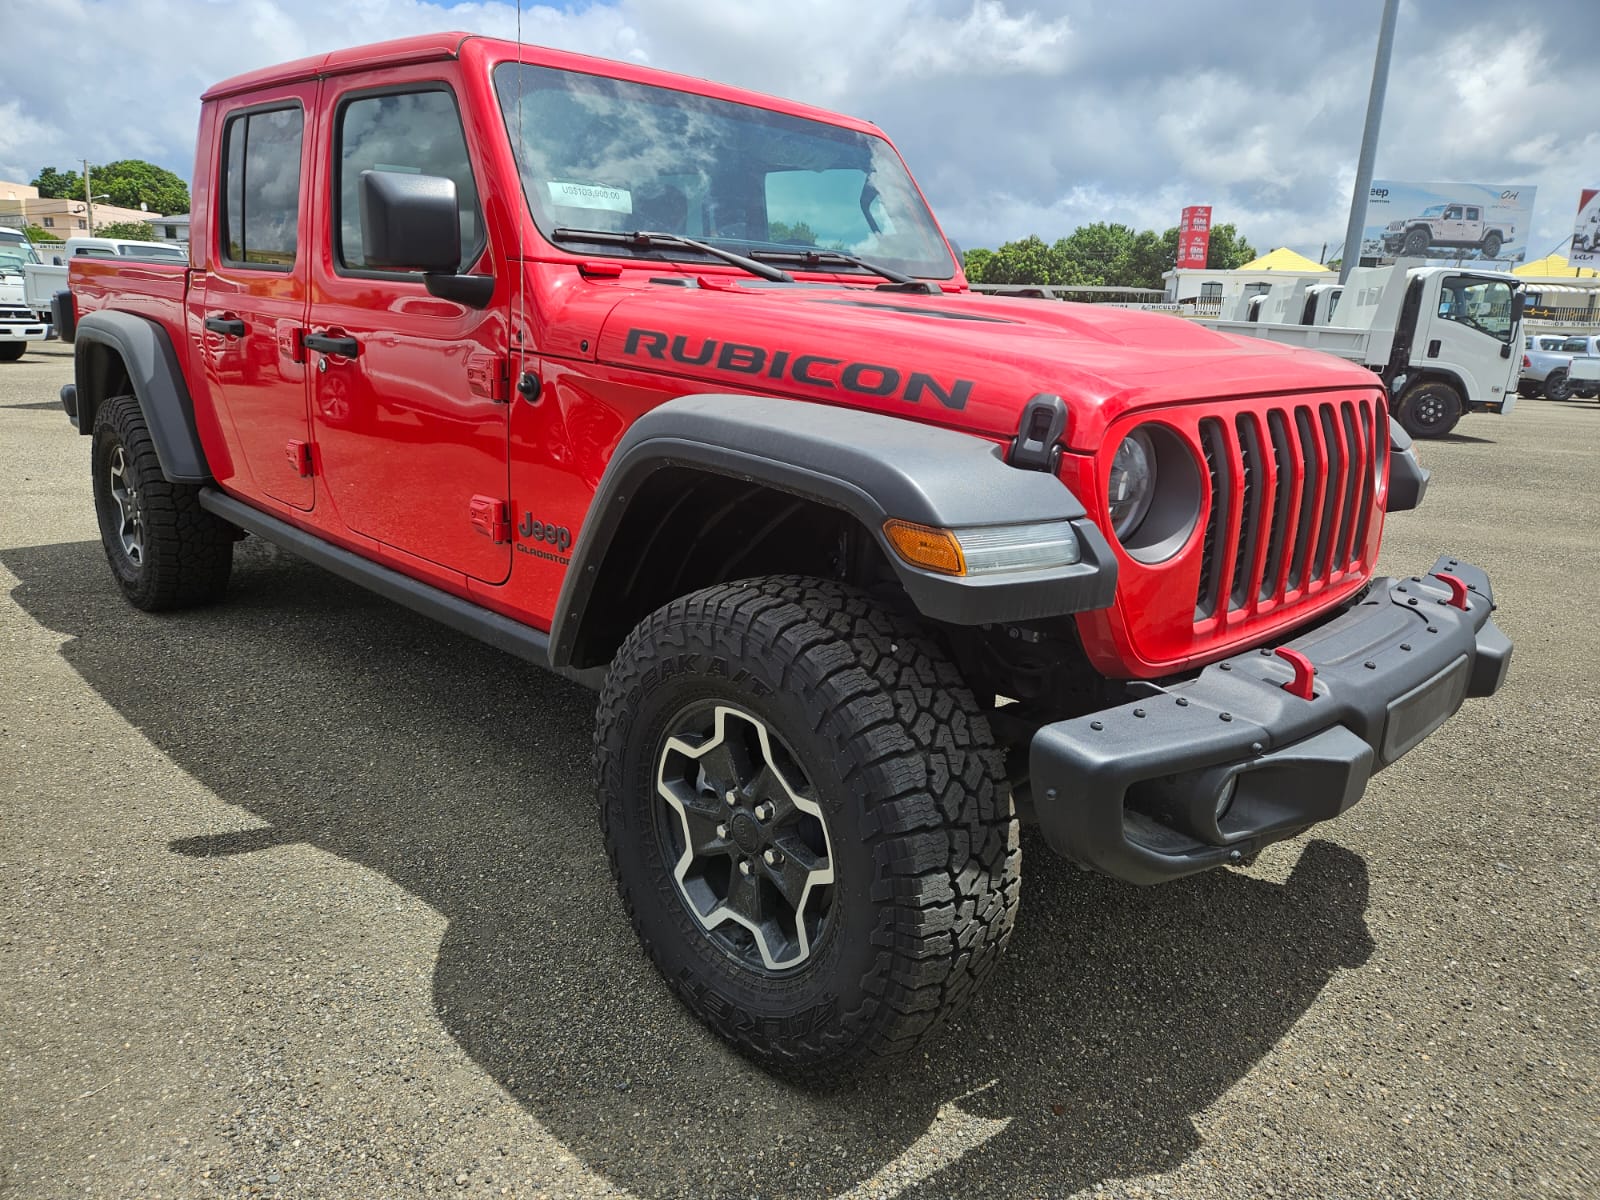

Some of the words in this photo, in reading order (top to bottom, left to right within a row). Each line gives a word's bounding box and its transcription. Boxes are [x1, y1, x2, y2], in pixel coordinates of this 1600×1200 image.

[1370, 188, 1389, 198] eep
[623, 328, 974, 412] RUBICON
[518, 511, 571, 552] Jeep
